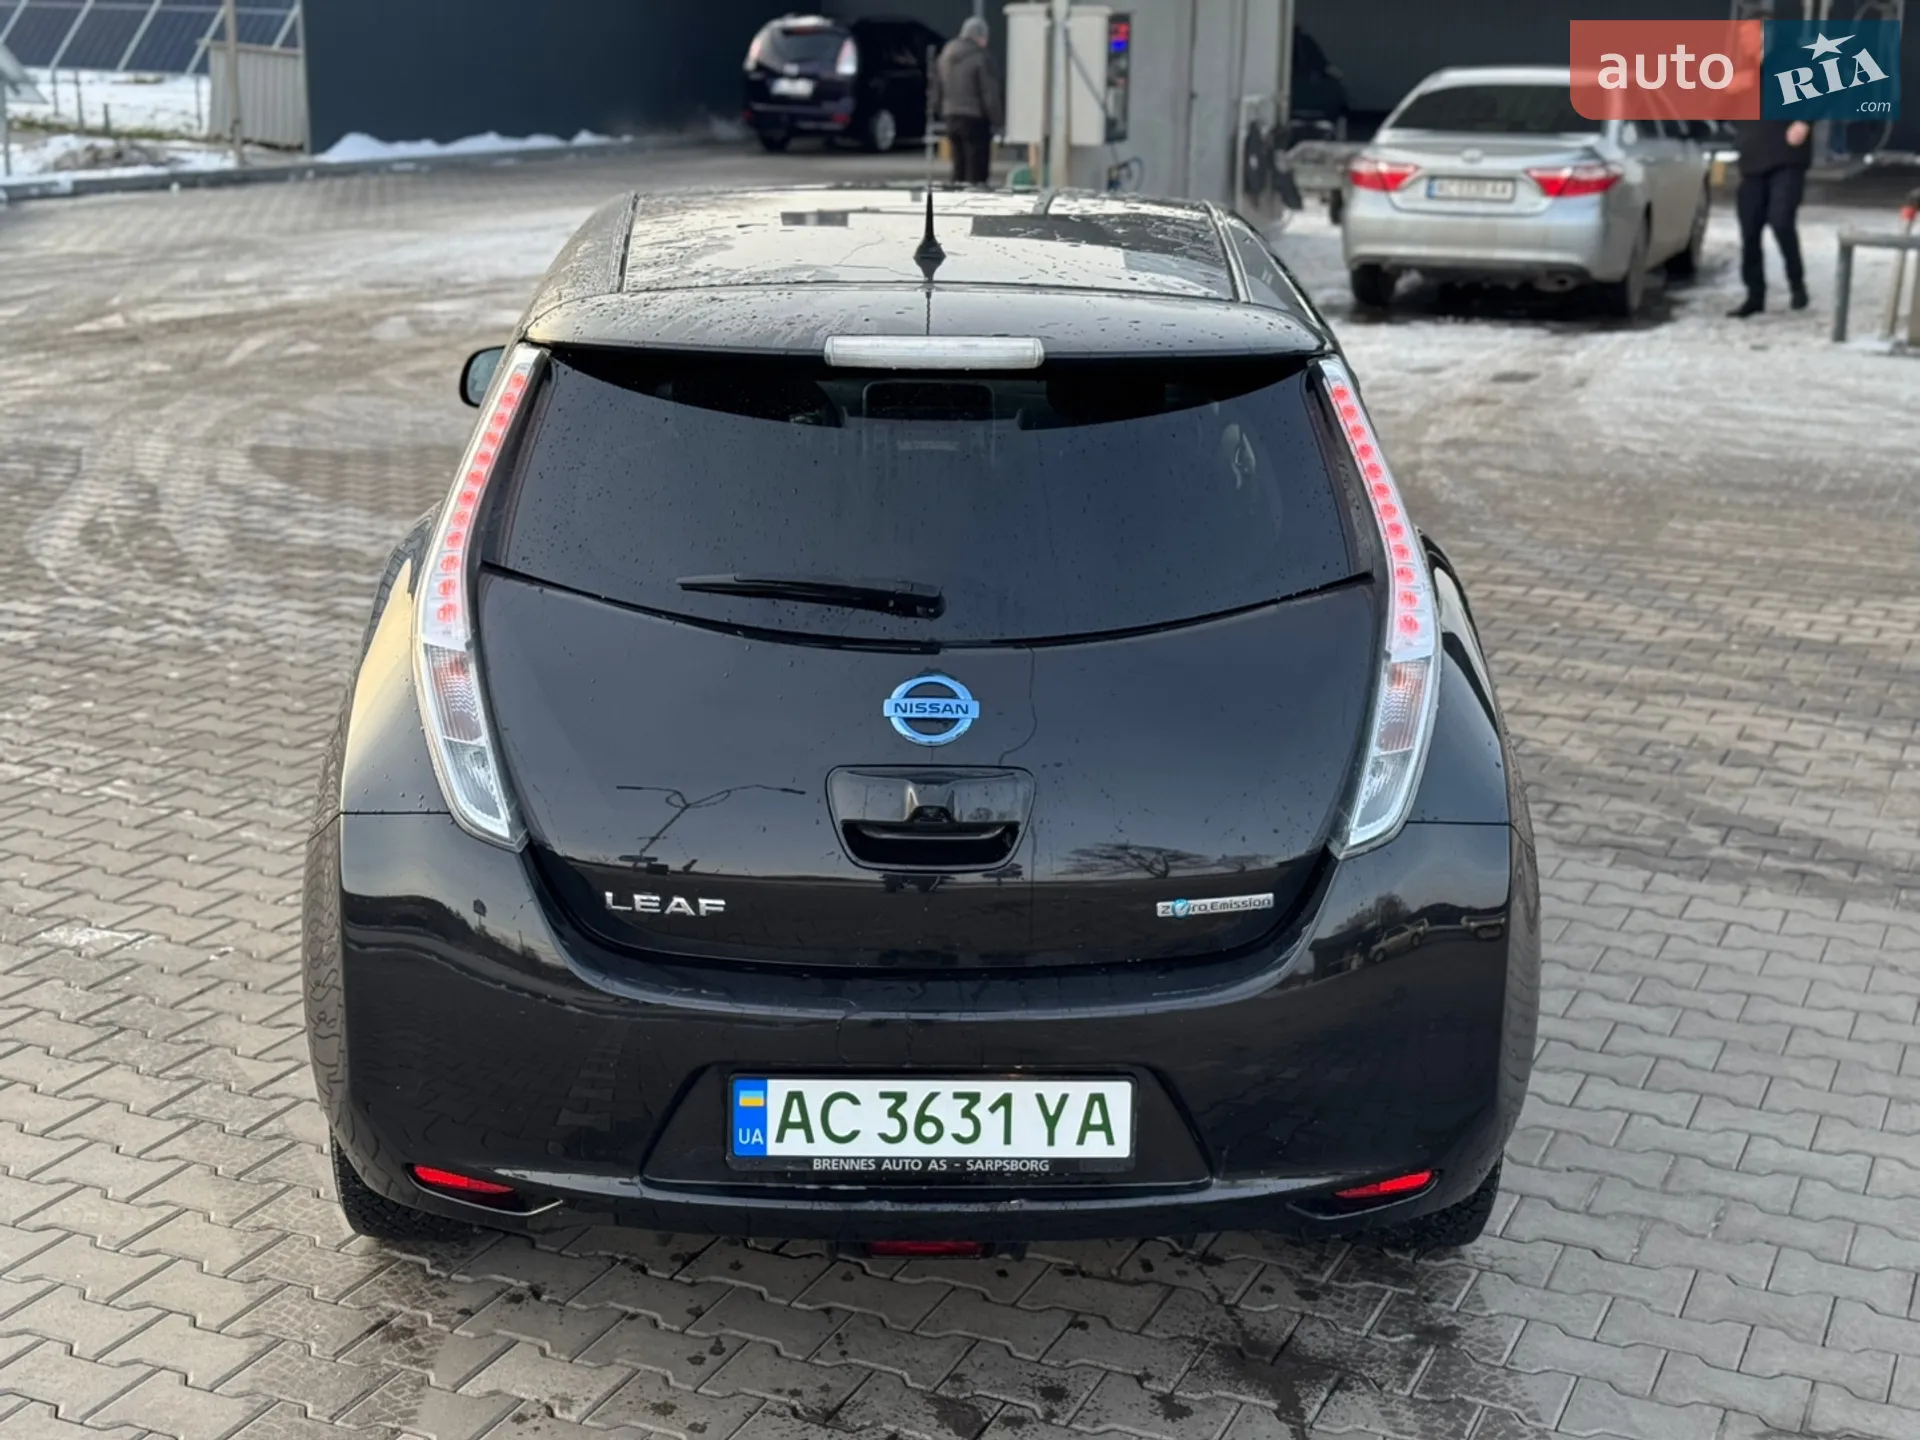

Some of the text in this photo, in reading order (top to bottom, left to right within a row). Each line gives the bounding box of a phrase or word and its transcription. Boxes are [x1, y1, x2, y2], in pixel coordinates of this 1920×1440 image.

[894, 702, 969, 715] NISSAN
[605, 891, 726, 916] LEAF
[775, 1090, 1116, 1147] AC 3631 YA
[738, 1127, 764, 1146] UA
[812, 1158, 876, 1171] BRENNES
[882, 1159, 922, 1171] AUTO
[928, 1159, 948, 1171] AS
[966, 1159, 1050, 1172] SARPSBORG
